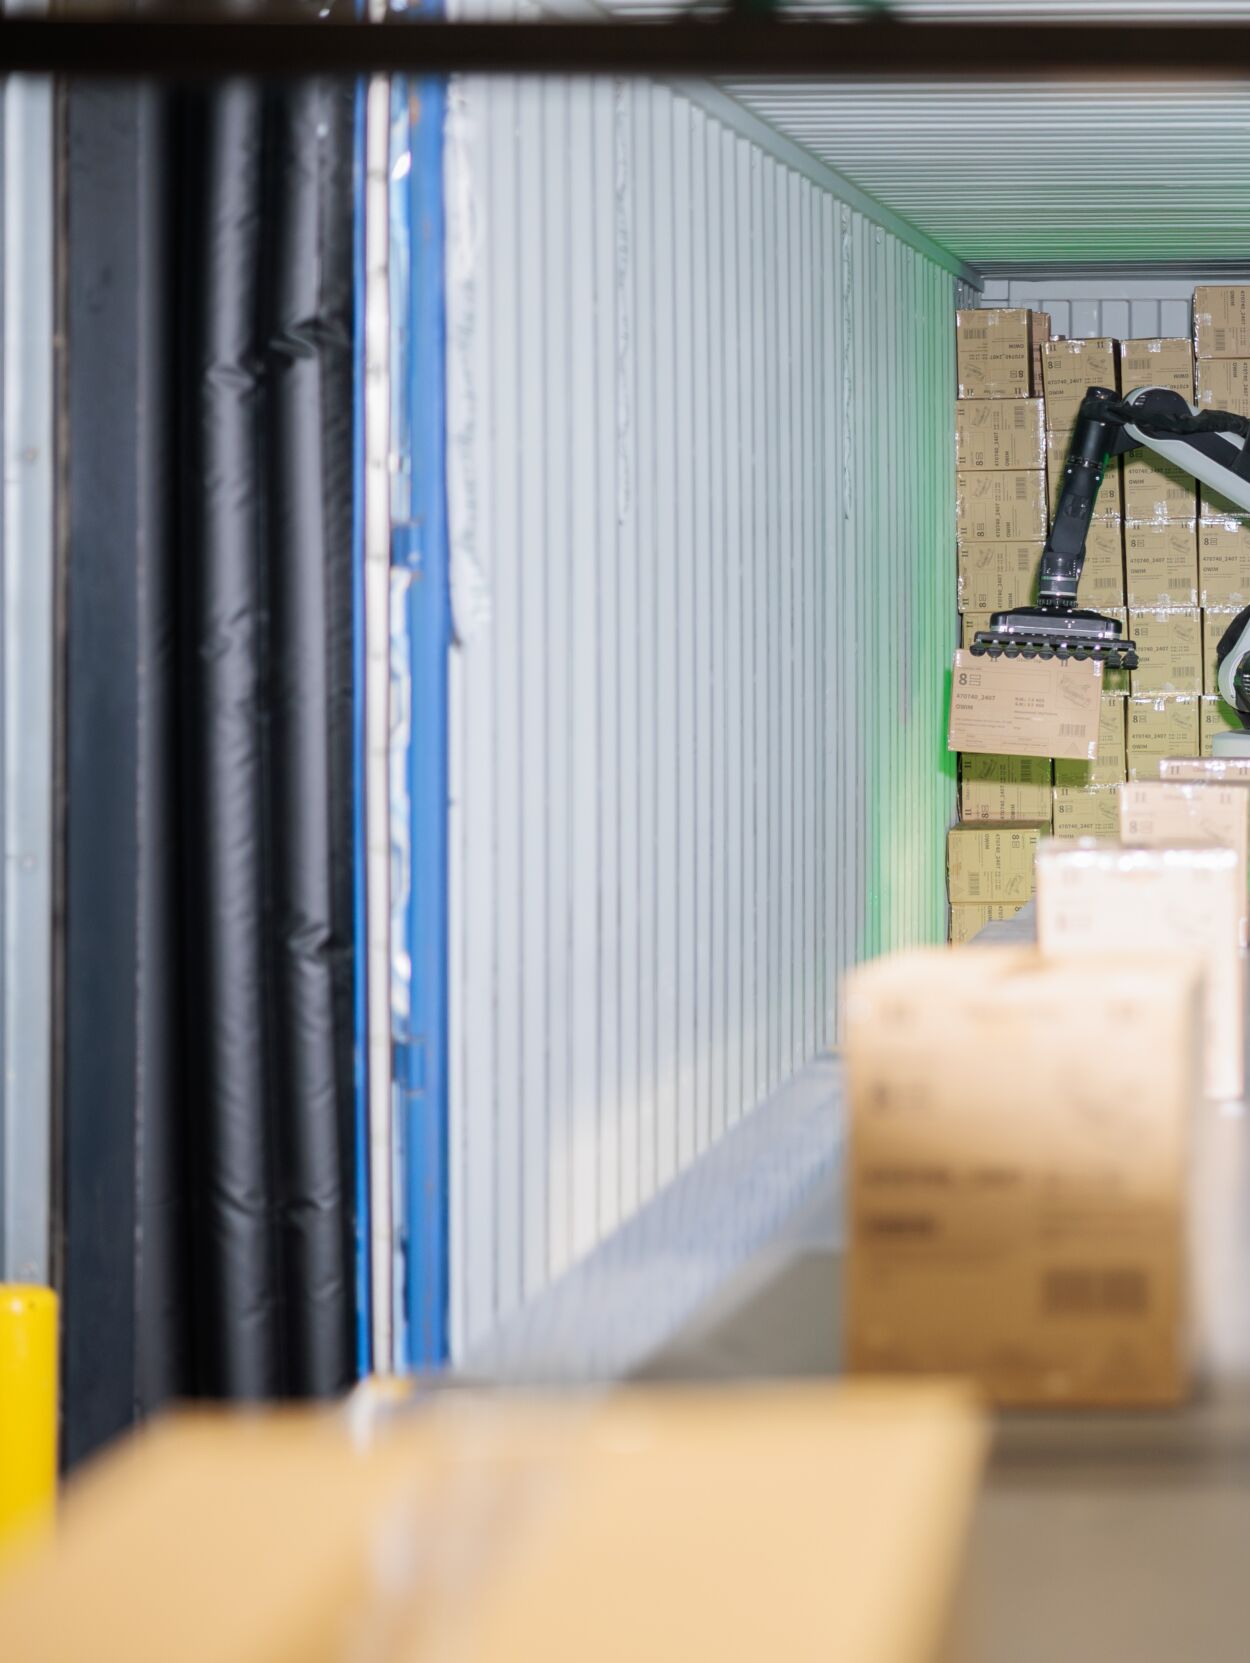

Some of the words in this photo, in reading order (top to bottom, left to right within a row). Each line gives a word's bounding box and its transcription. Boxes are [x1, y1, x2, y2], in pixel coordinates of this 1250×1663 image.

[1048, 361, 1053, 369] 8
[1019, 370, 1024, 378] 8
[1109, 490, 1115, 498] 8
[1131, 540, 1136, 548] 8
[1134, 628, 1140, 636] 8
[959, 673, 968, 685] 8
[1132, 715, 1138, 724] 8
[1206, 715, 1212, 724] 8
[1059, 805, 1064, 813] 8
[1129, 820, 1137, 834] 8
